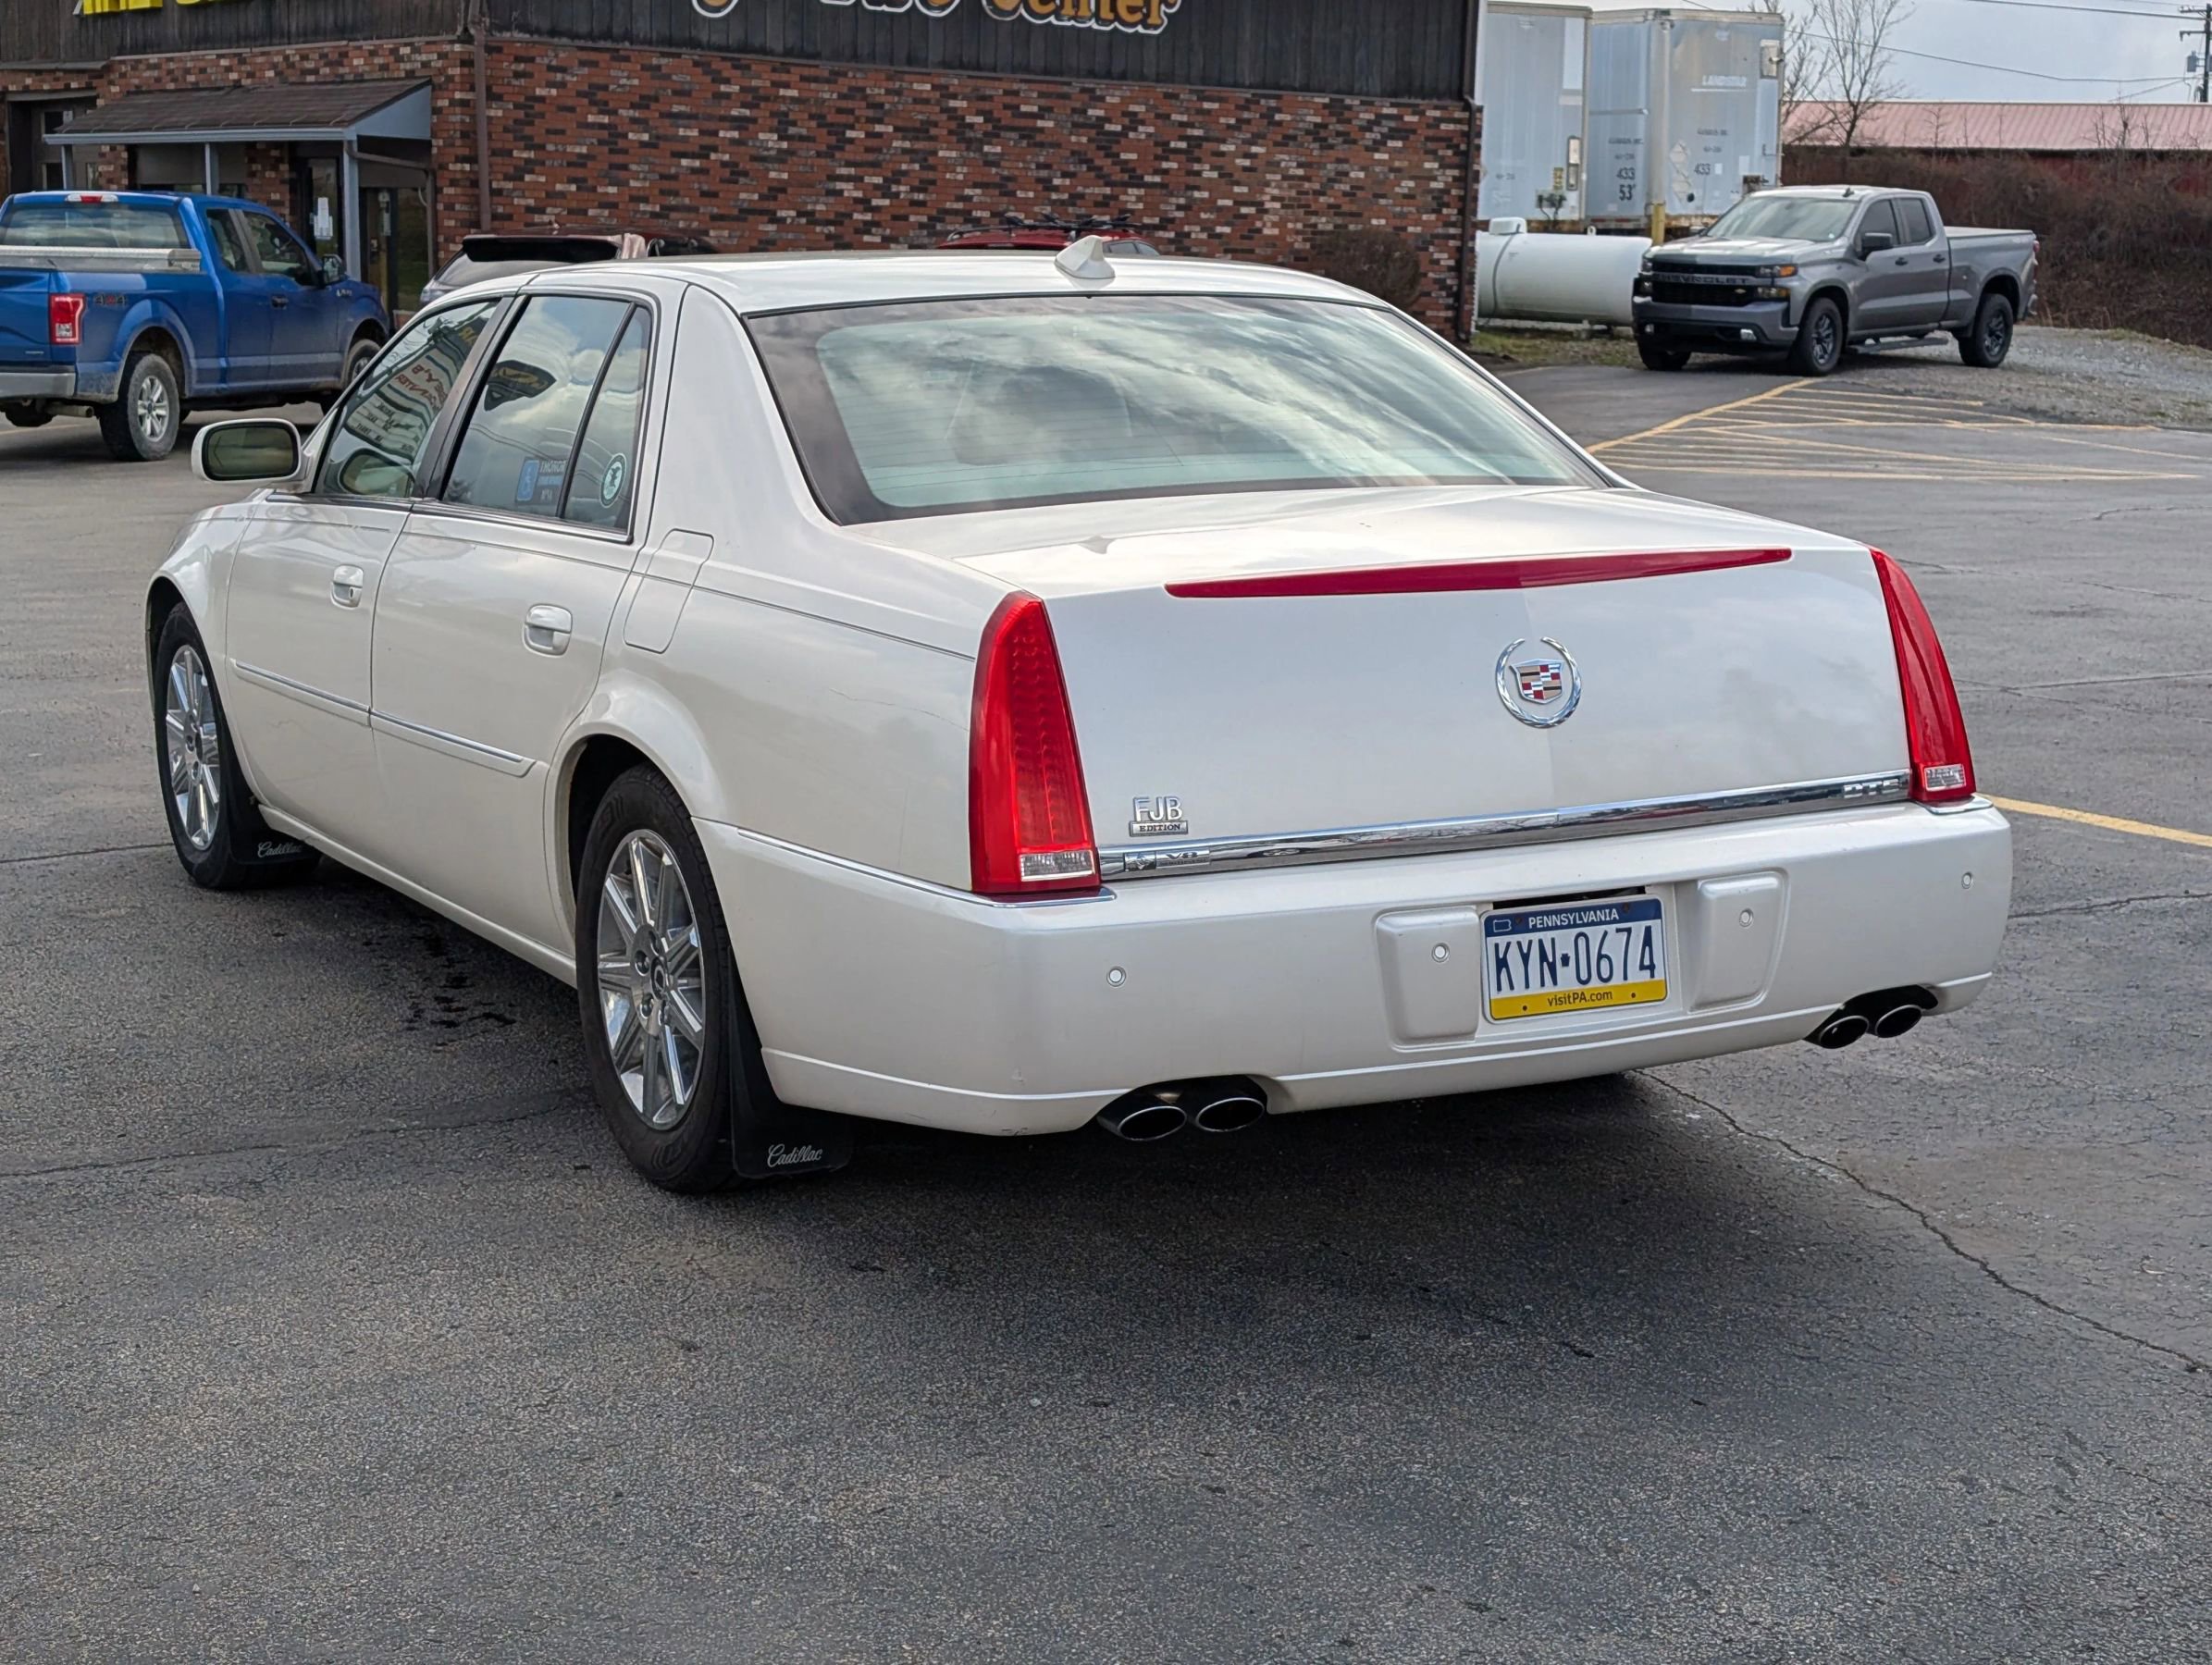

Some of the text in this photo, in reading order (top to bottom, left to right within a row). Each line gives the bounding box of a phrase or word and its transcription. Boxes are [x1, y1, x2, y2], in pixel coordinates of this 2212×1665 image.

[988, 0, 1177, 26] enter
[1133, 796, 1183, 821] FJB
[1139, 823, 1180, 832] EDITION
[257, 841, 303, 857] Cadillac
[1528, 907, 1619, 929] PENNSYLVANIA
[1547, 990, 1613, 1006] visitPA.com
[767, 1143, 823, 1167] Cadillac
